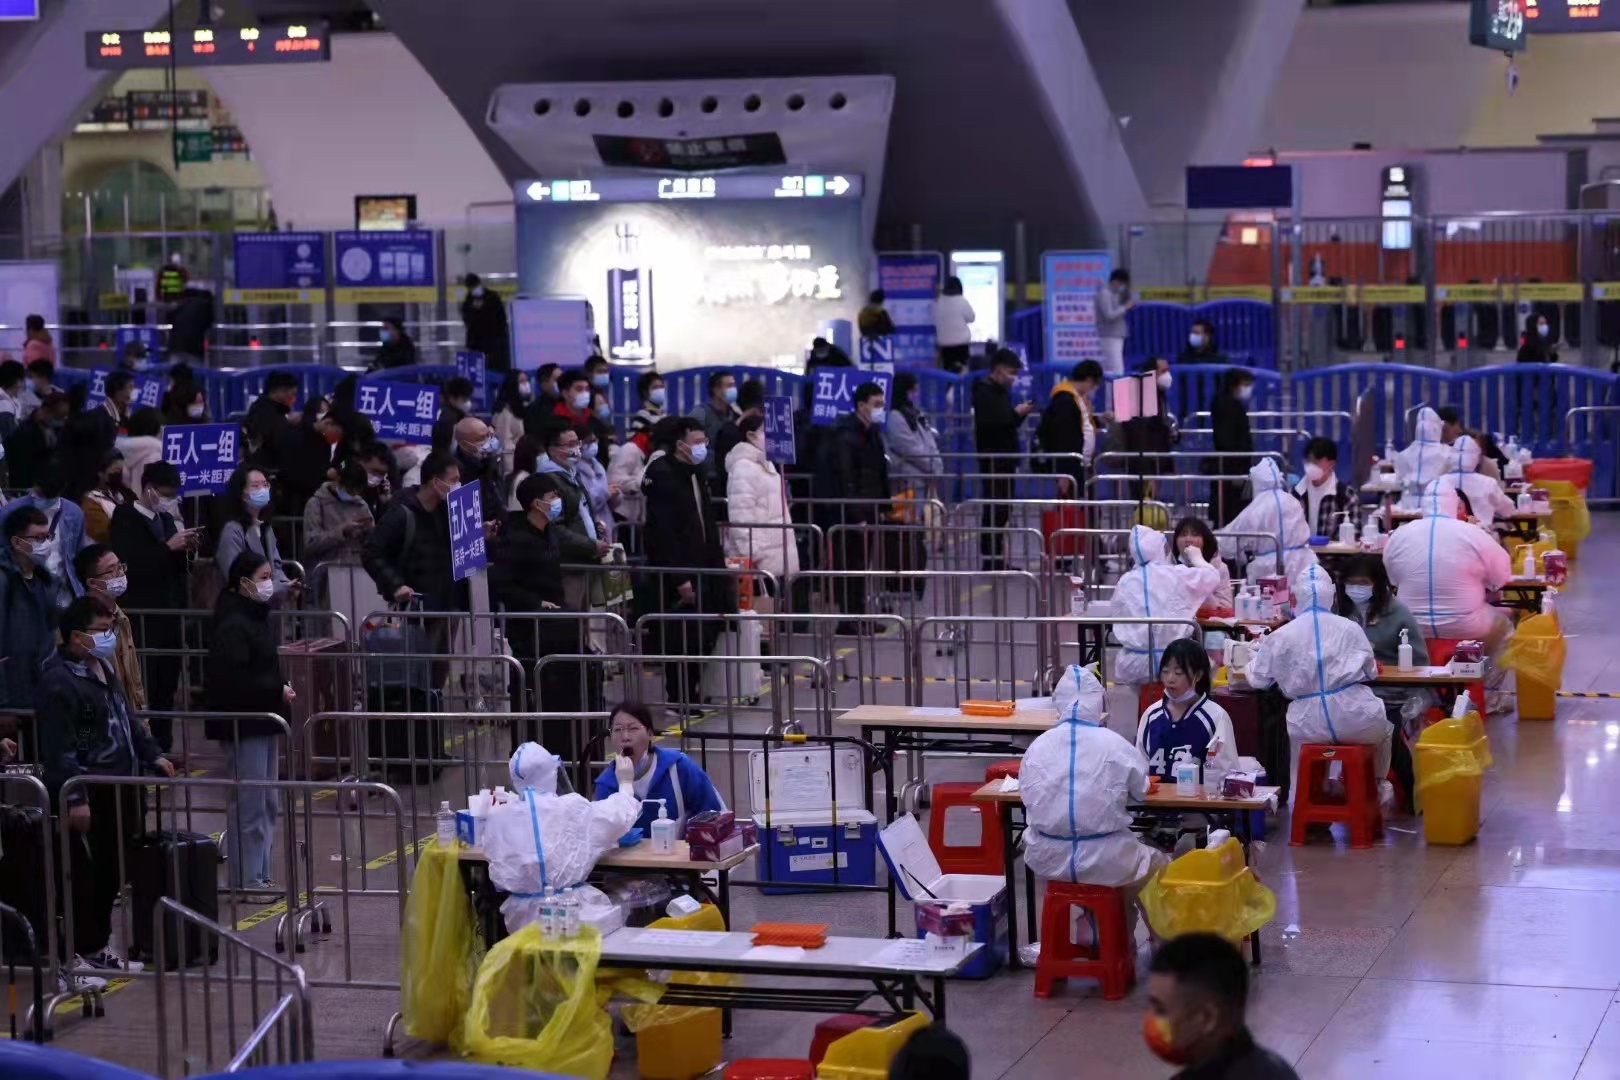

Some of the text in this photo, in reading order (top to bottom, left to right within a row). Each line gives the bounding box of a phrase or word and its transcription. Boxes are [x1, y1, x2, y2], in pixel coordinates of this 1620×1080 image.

[90, 370, 160, 407] 五组
[359, 385, 435, 419] 五人一组
[763, 402, 791, 434] 五人一组
[166, 430, 235, 465] 五人一组
[450, 489, 482, 541] 五人一组
